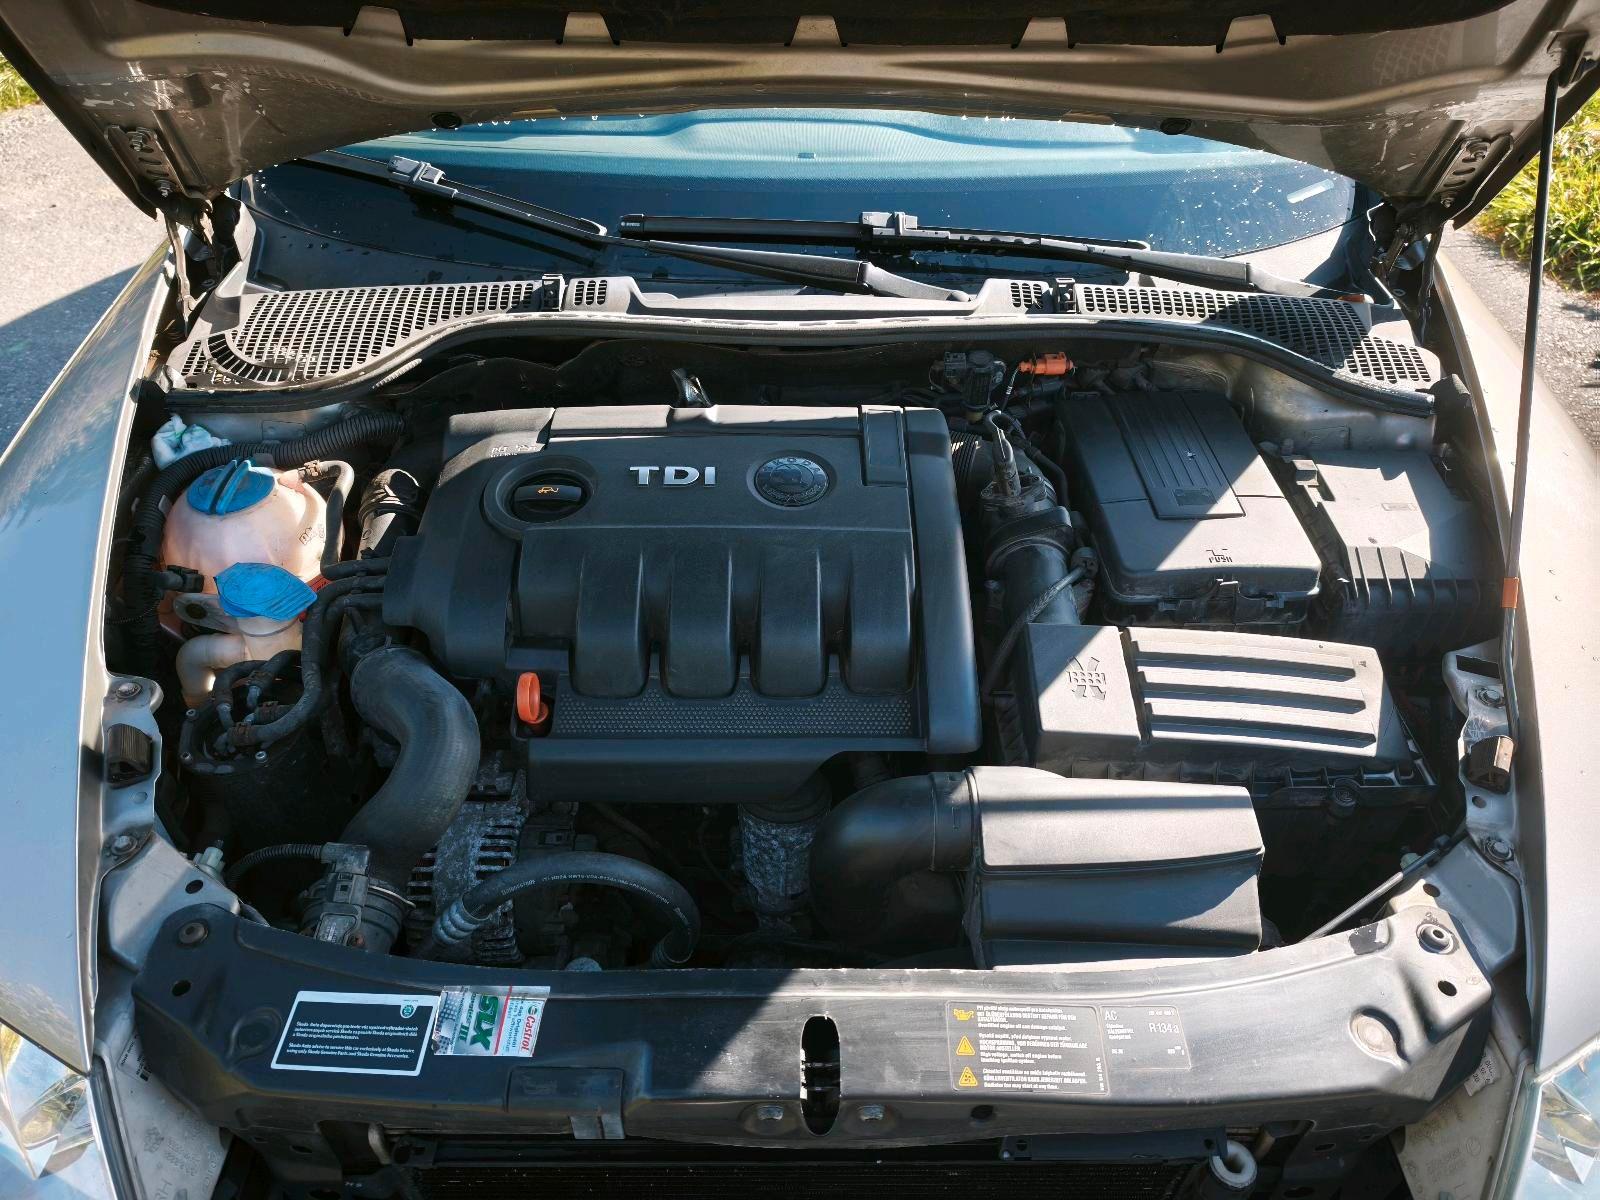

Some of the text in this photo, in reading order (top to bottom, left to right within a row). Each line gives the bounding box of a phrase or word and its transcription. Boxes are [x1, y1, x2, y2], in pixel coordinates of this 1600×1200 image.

[630, 466, 716, 487] TDI
[470, 995, 499, 1051] SLX
[1104, 1010, 1118, 1021] AC
[522, 1015, 536, 1051] Castrol
